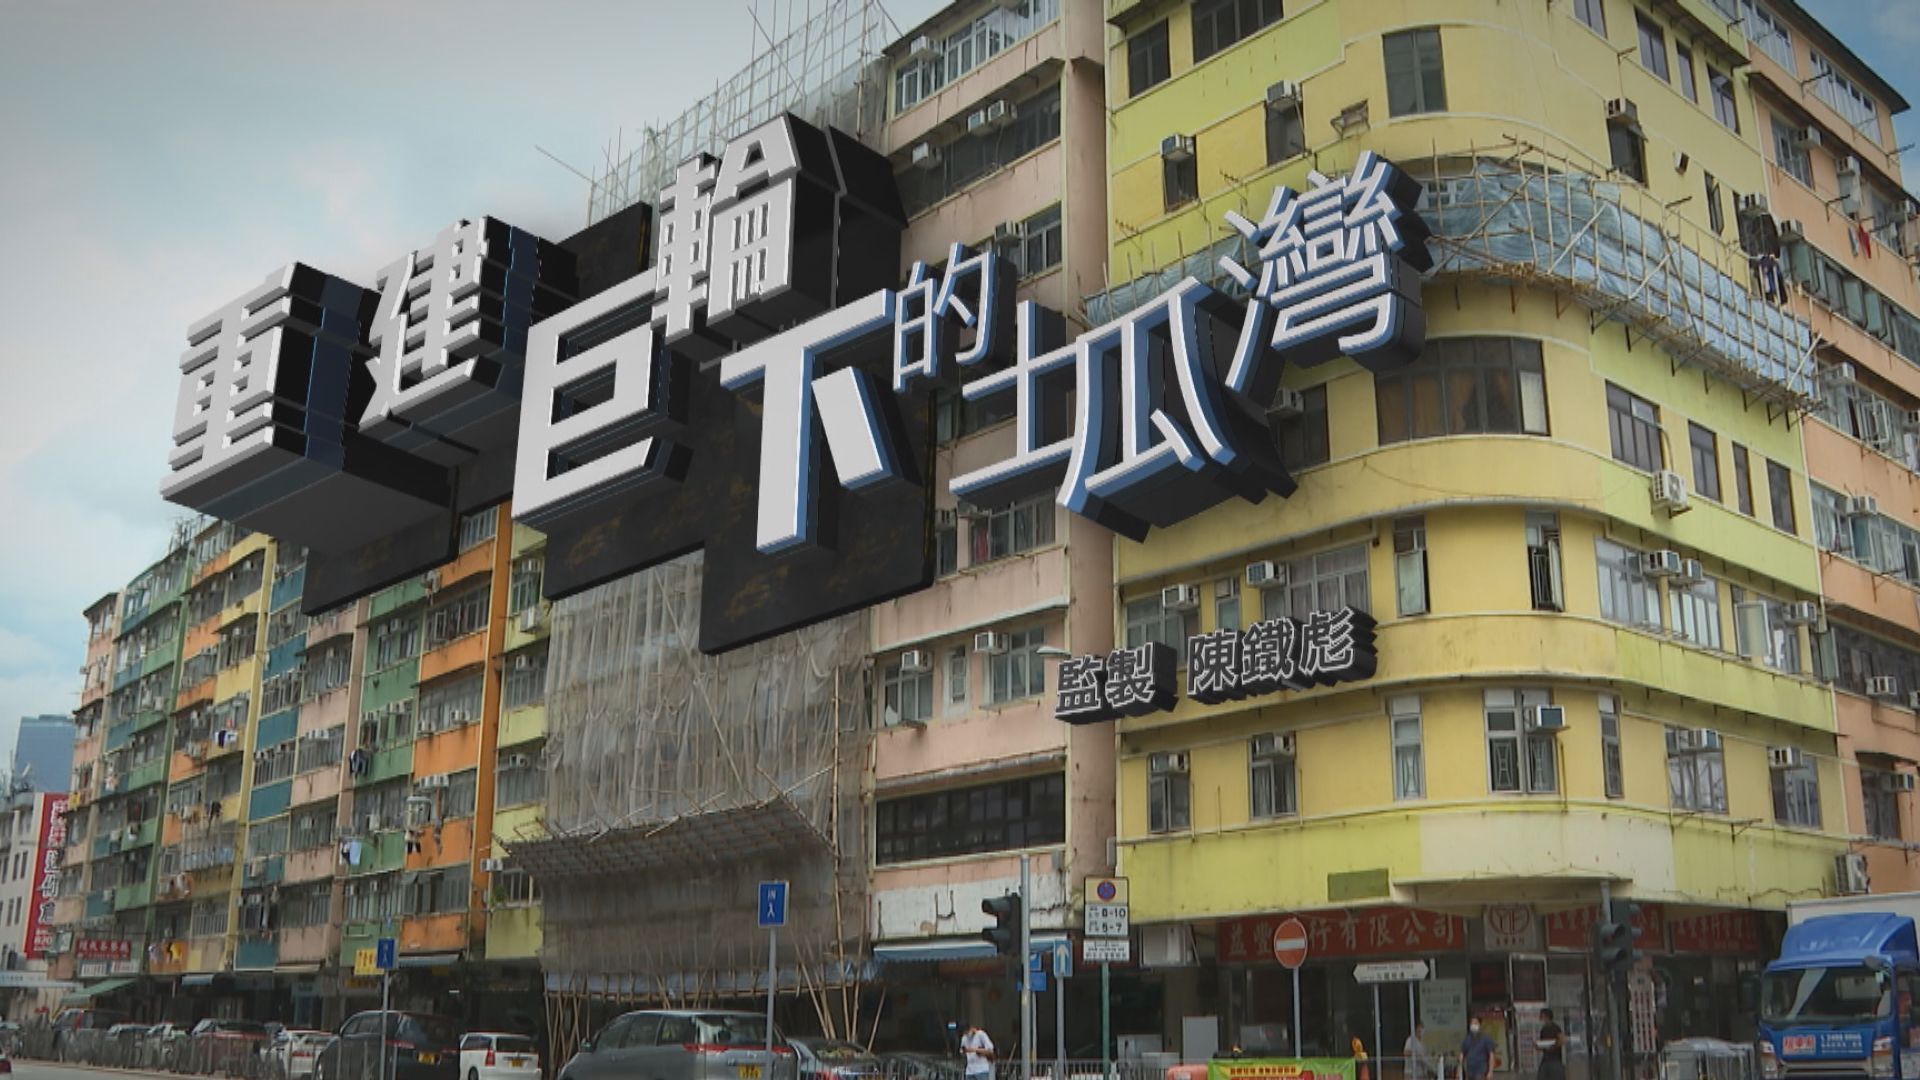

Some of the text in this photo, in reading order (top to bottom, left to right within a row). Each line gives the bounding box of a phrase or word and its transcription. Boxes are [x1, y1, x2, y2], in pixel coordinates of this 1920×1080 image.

[1228, 911, 1456, 957] 益豐行有限公司
